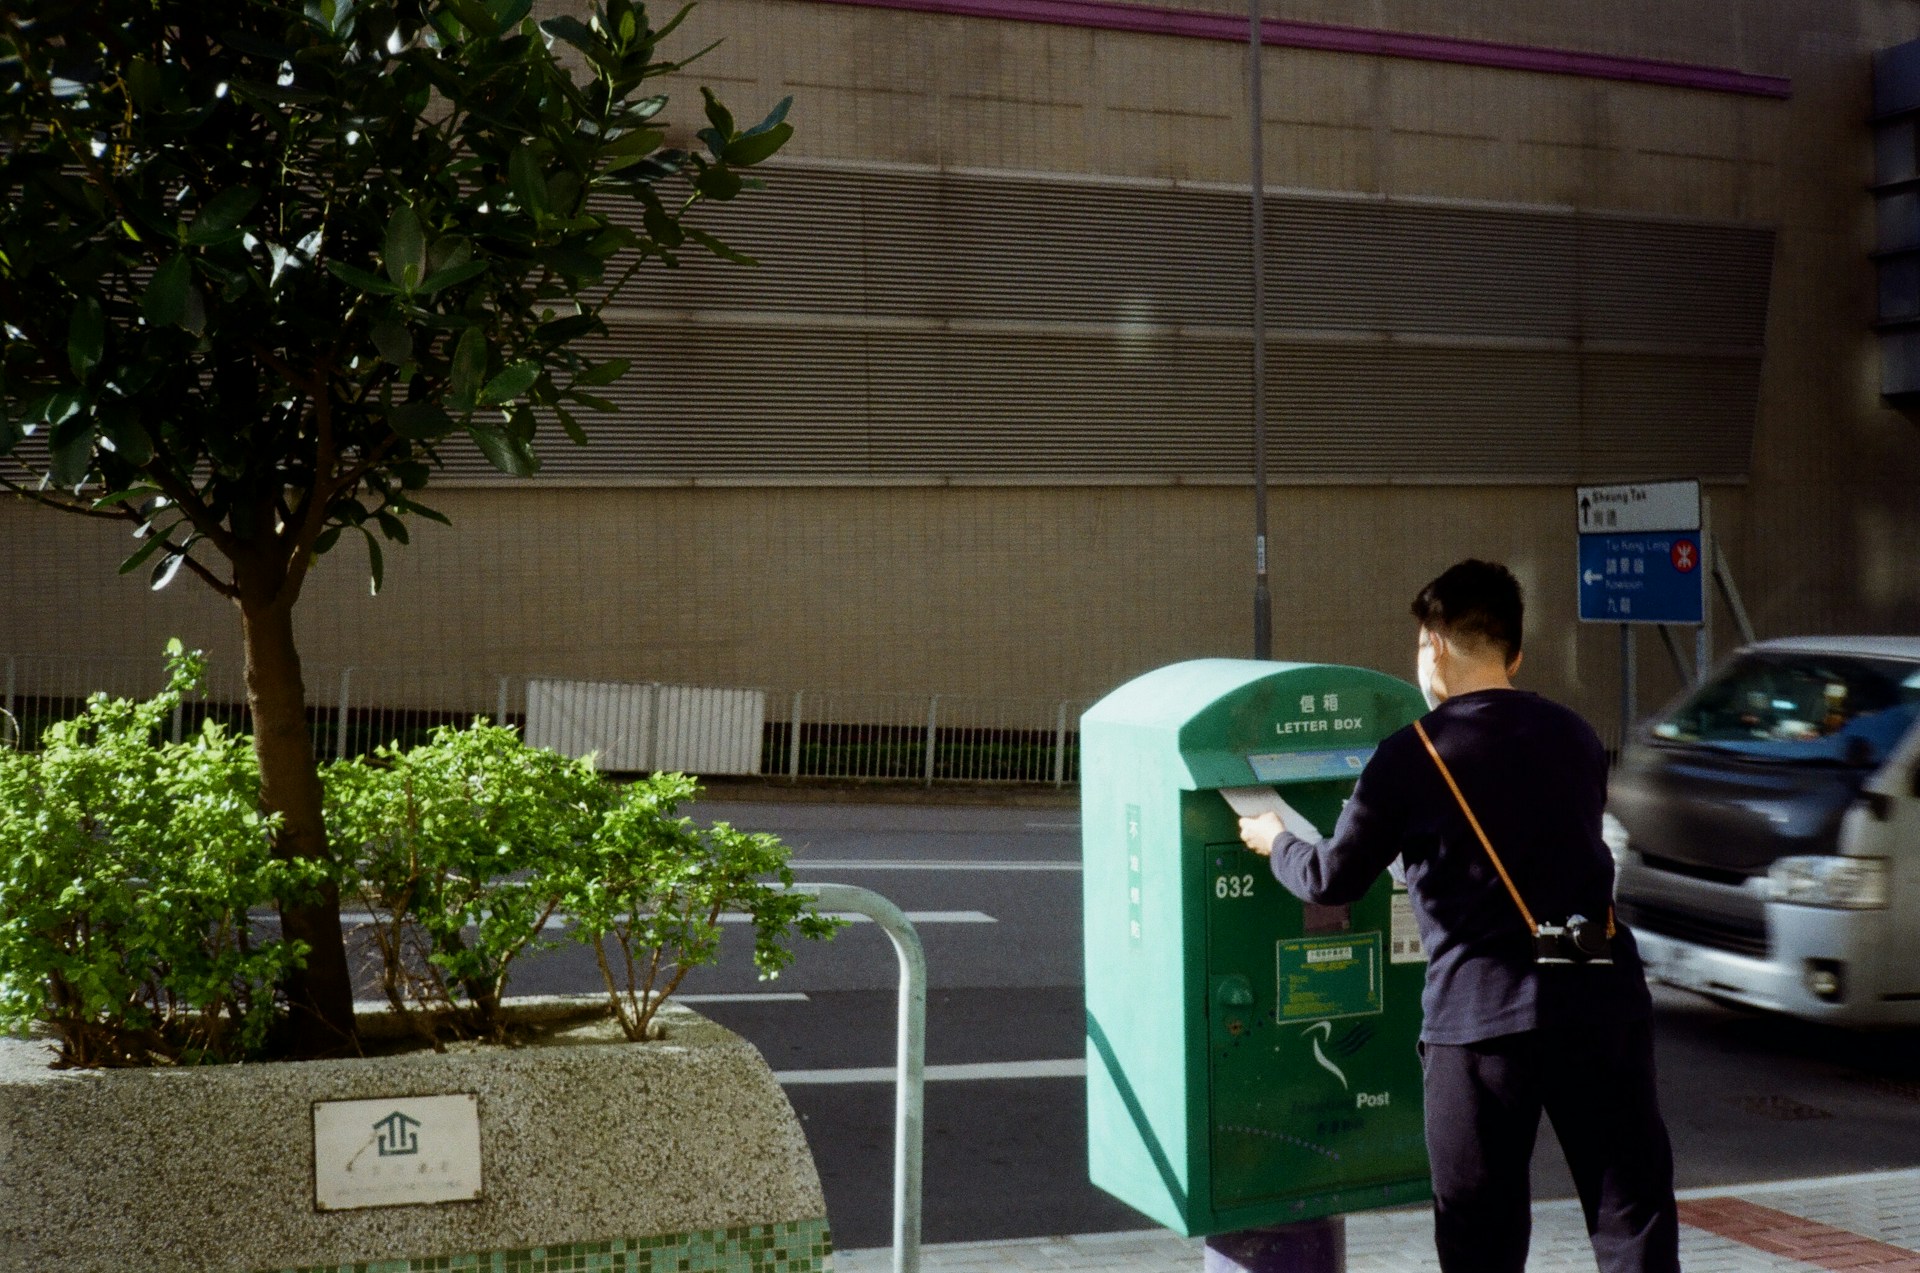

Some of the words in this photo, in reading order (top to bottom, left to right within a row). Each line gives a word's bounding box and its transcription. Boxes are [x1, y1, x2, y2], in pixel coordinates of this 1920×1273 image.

[1300, 693, 1339, 713] 信箱
[1276, 720, 1328, 734] LETTER
[1334, 717, 1362, 731] BOX
[1215, 875, 1254, 899] 632
[1356, 1091, 1390, 1108] Post
